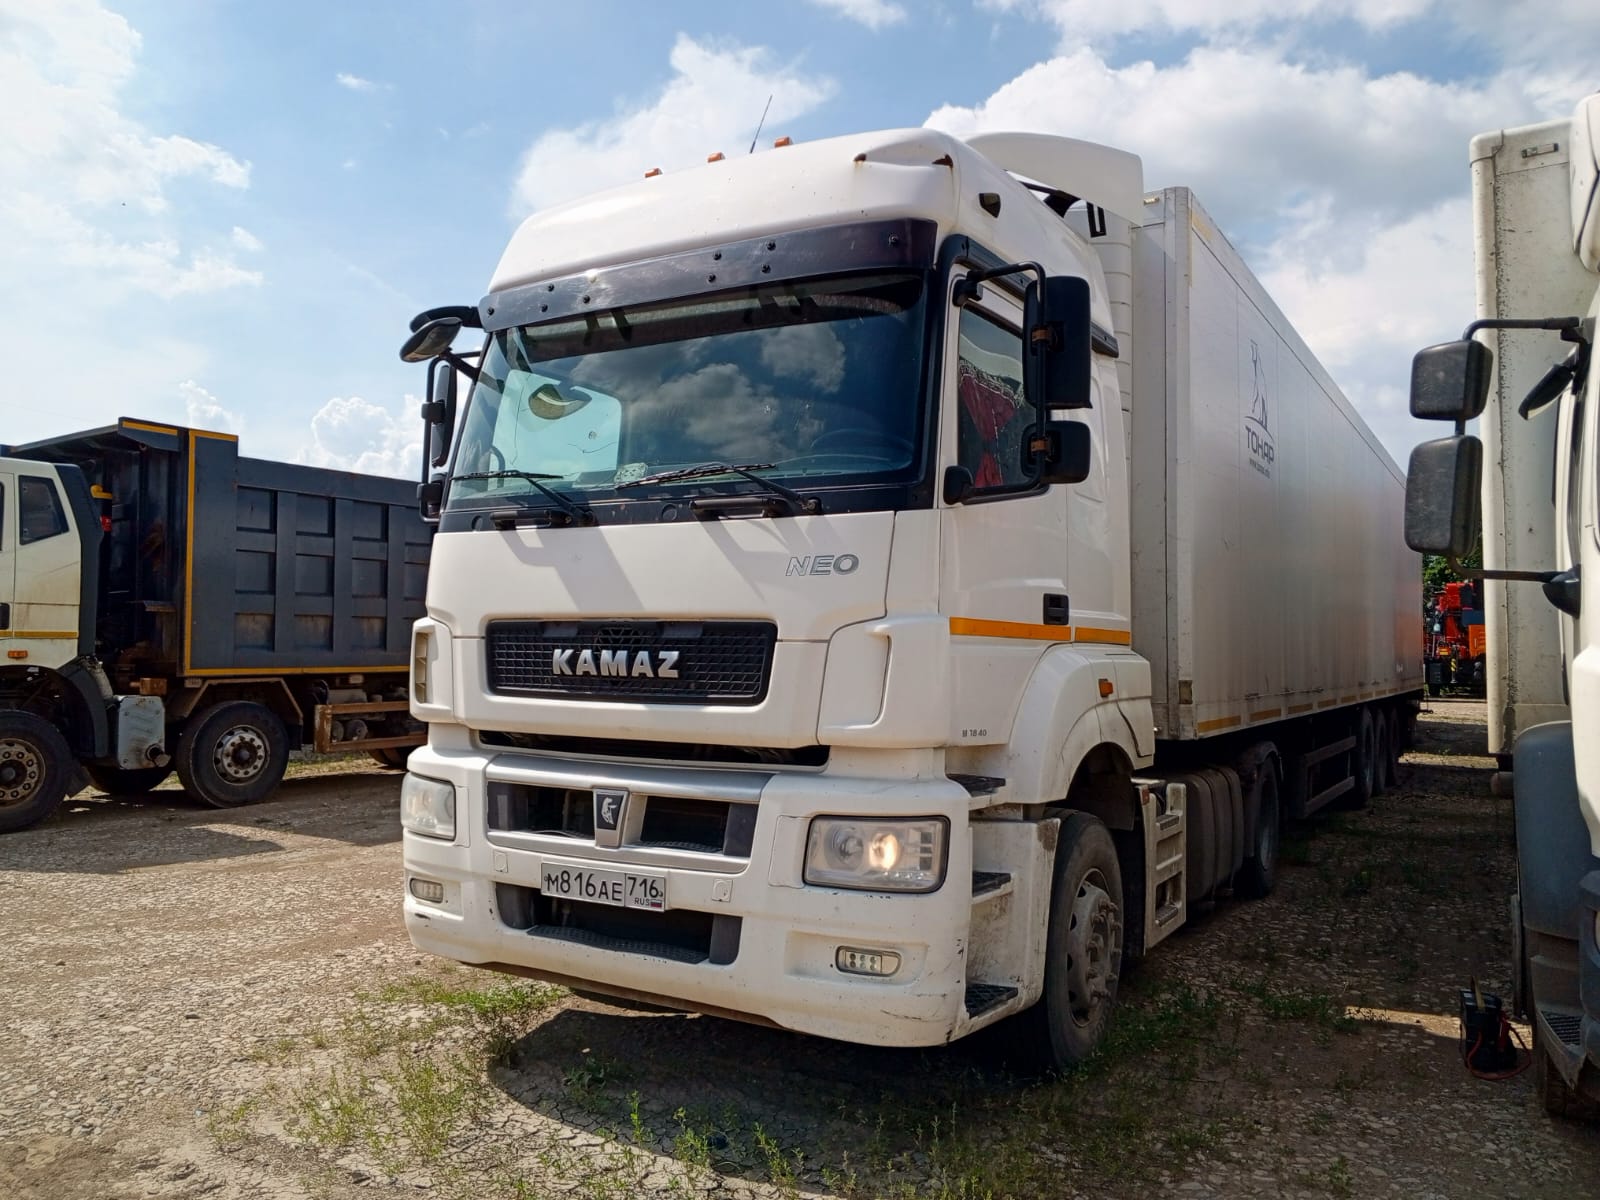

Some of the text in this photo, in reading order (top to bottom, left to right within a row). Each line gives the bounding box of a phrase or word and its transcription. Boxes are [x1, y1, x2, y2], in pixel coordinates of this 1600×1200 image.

[786, 553, 858, 576] NEO
[552, 649, 680, 679] KAMAZ
[627, 876, 659, 898] 716
[634, 897, 650, 906] RUS
